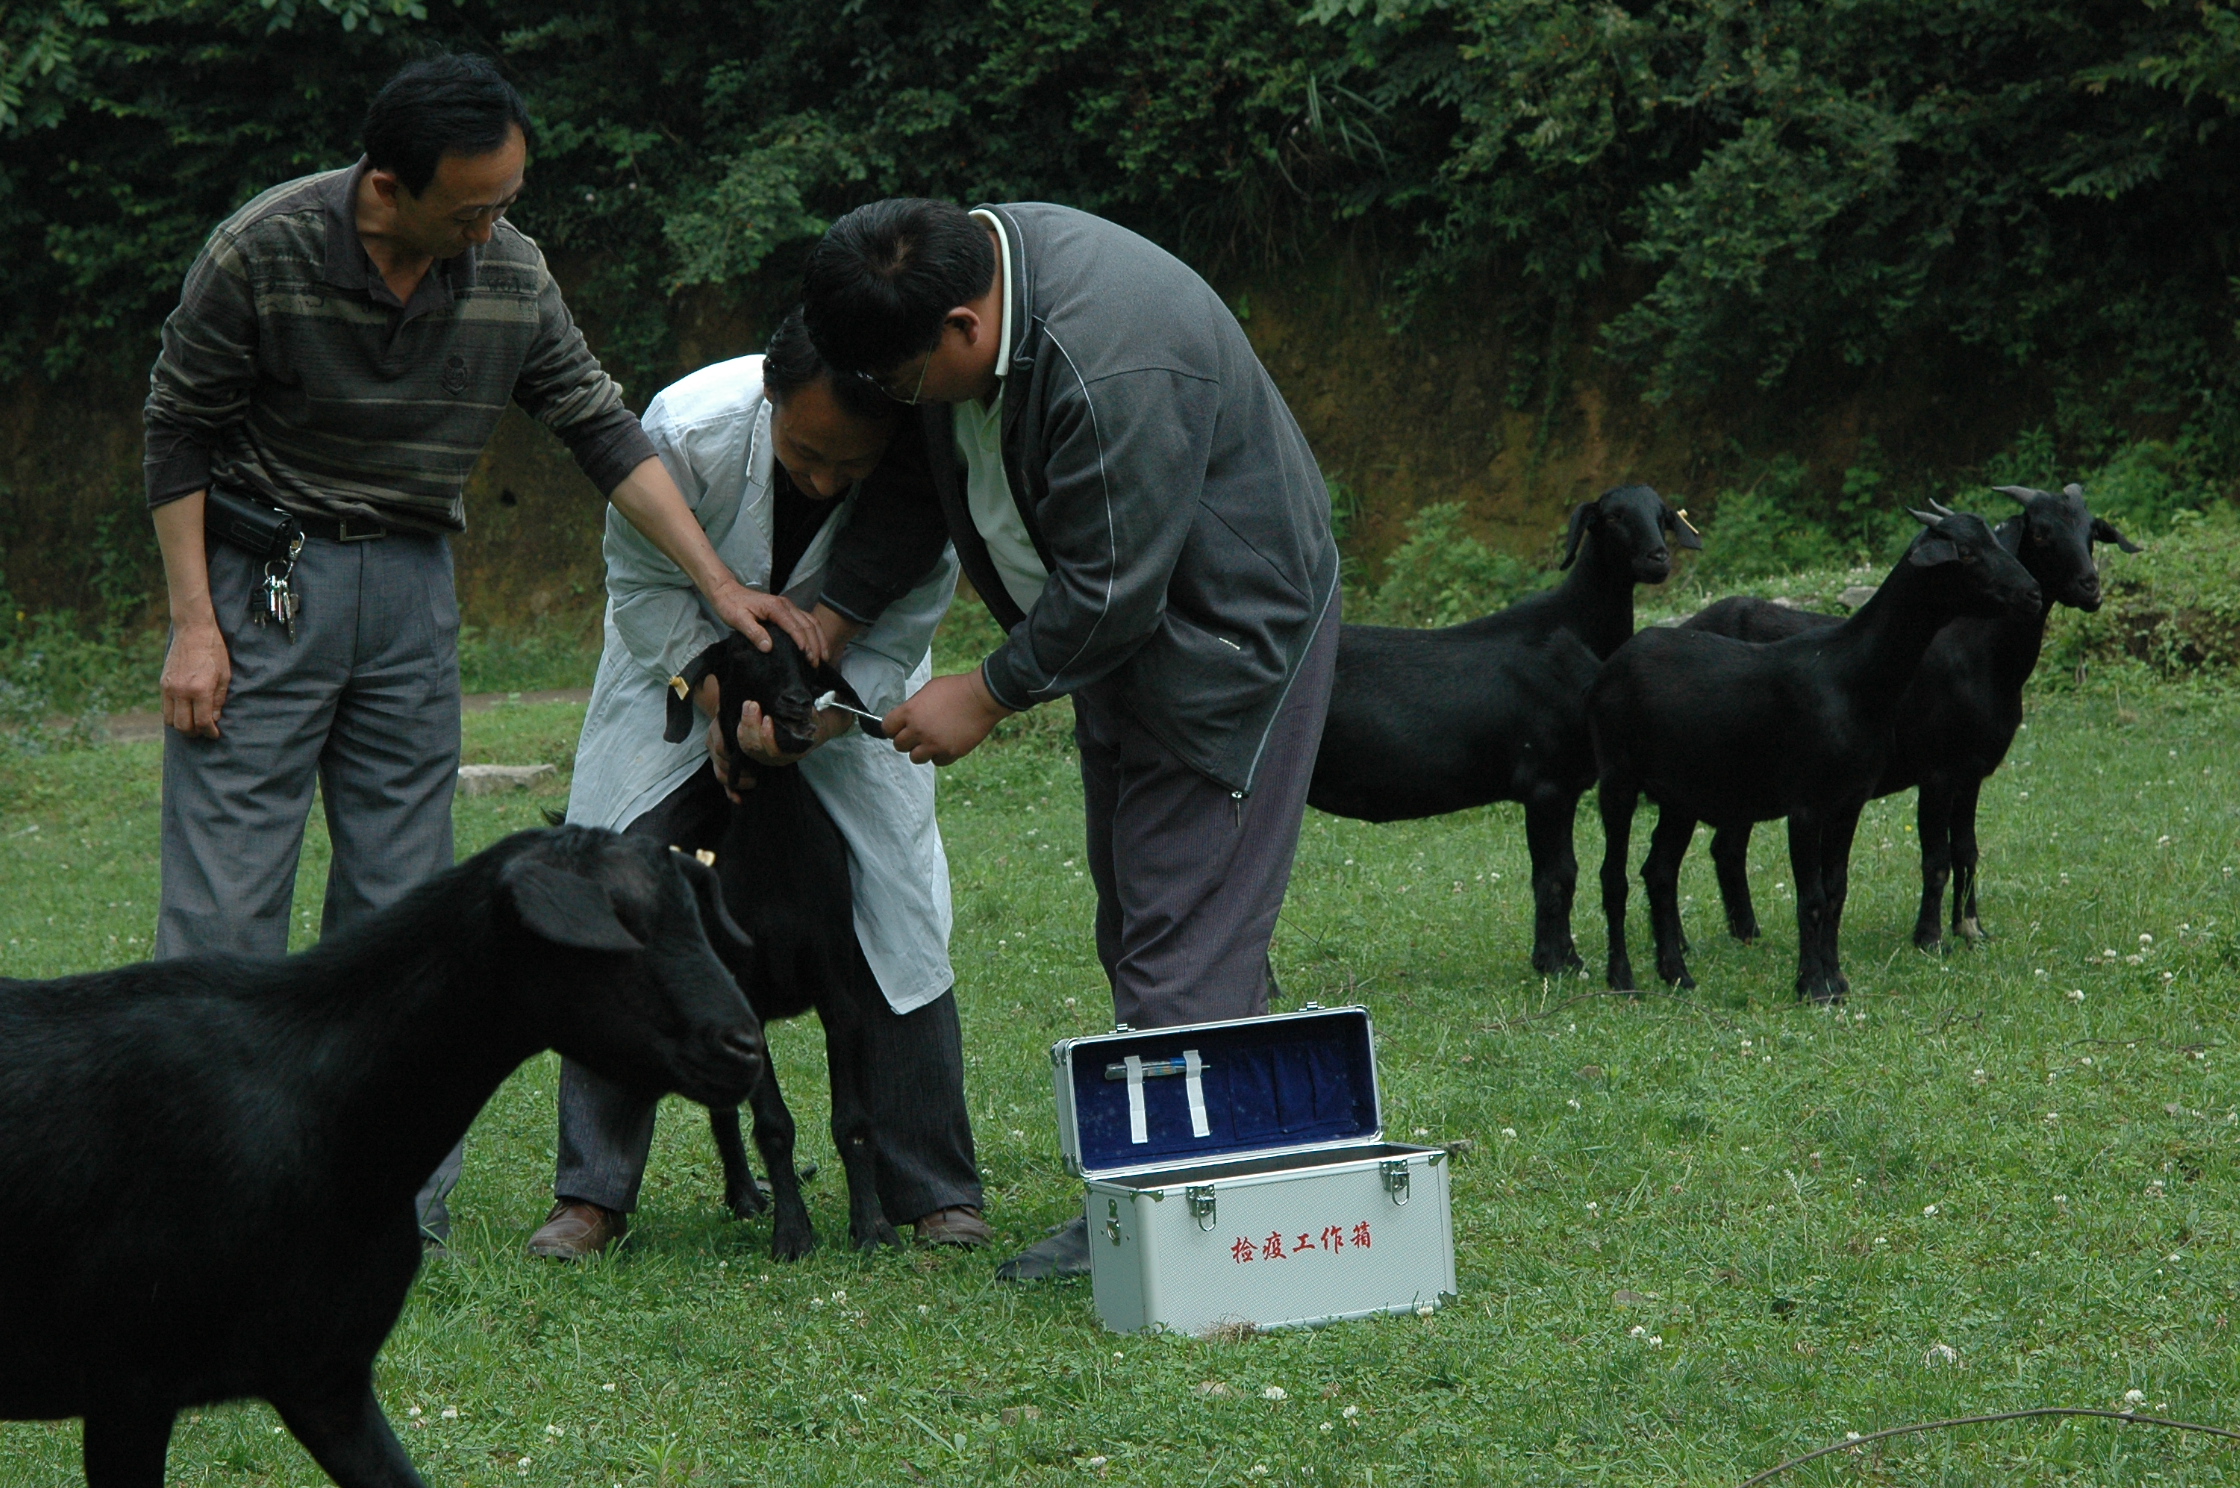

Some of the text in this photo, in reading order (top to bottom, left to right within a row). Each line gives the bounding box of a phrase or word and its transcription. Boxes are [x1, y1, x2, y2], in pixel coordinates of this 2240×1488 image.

[1231, 1221, 1371, 1263] 检疫工作箱
